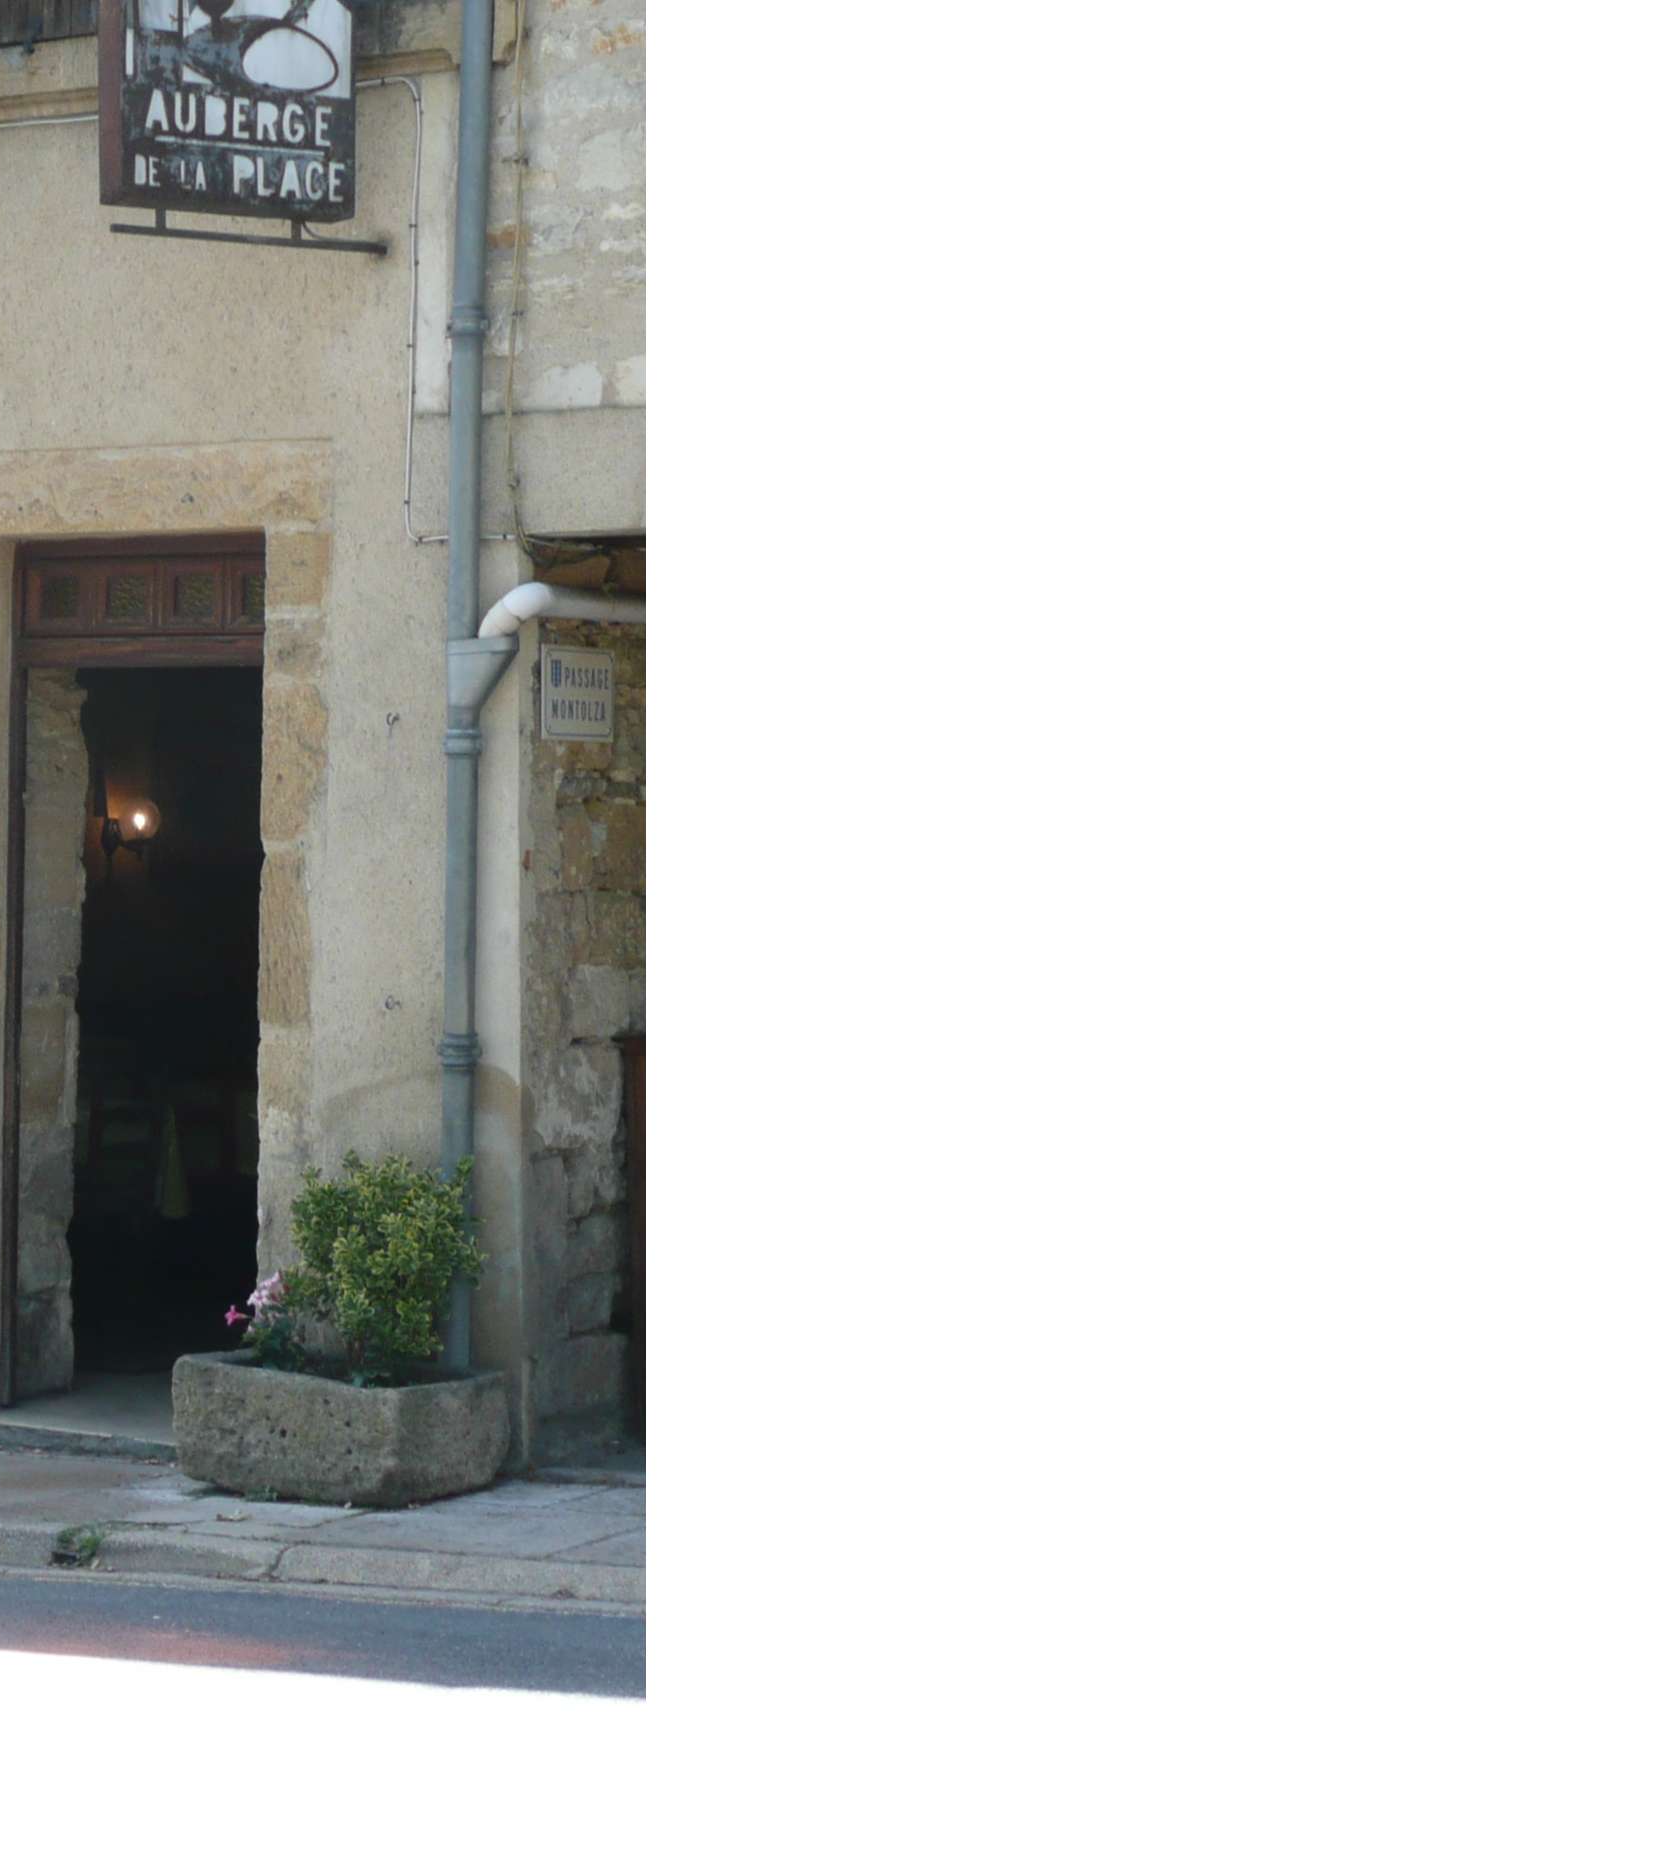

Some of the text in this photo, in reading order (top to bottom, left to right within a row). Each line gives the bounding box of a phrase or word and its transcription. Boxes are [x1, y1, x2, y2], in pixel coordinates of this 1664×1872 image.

[144, 88, 333, 147] AUBERGE
[134, 154, 345, 202] DE LA PLACE
[564, 666, 609, 691] PASSAGE
